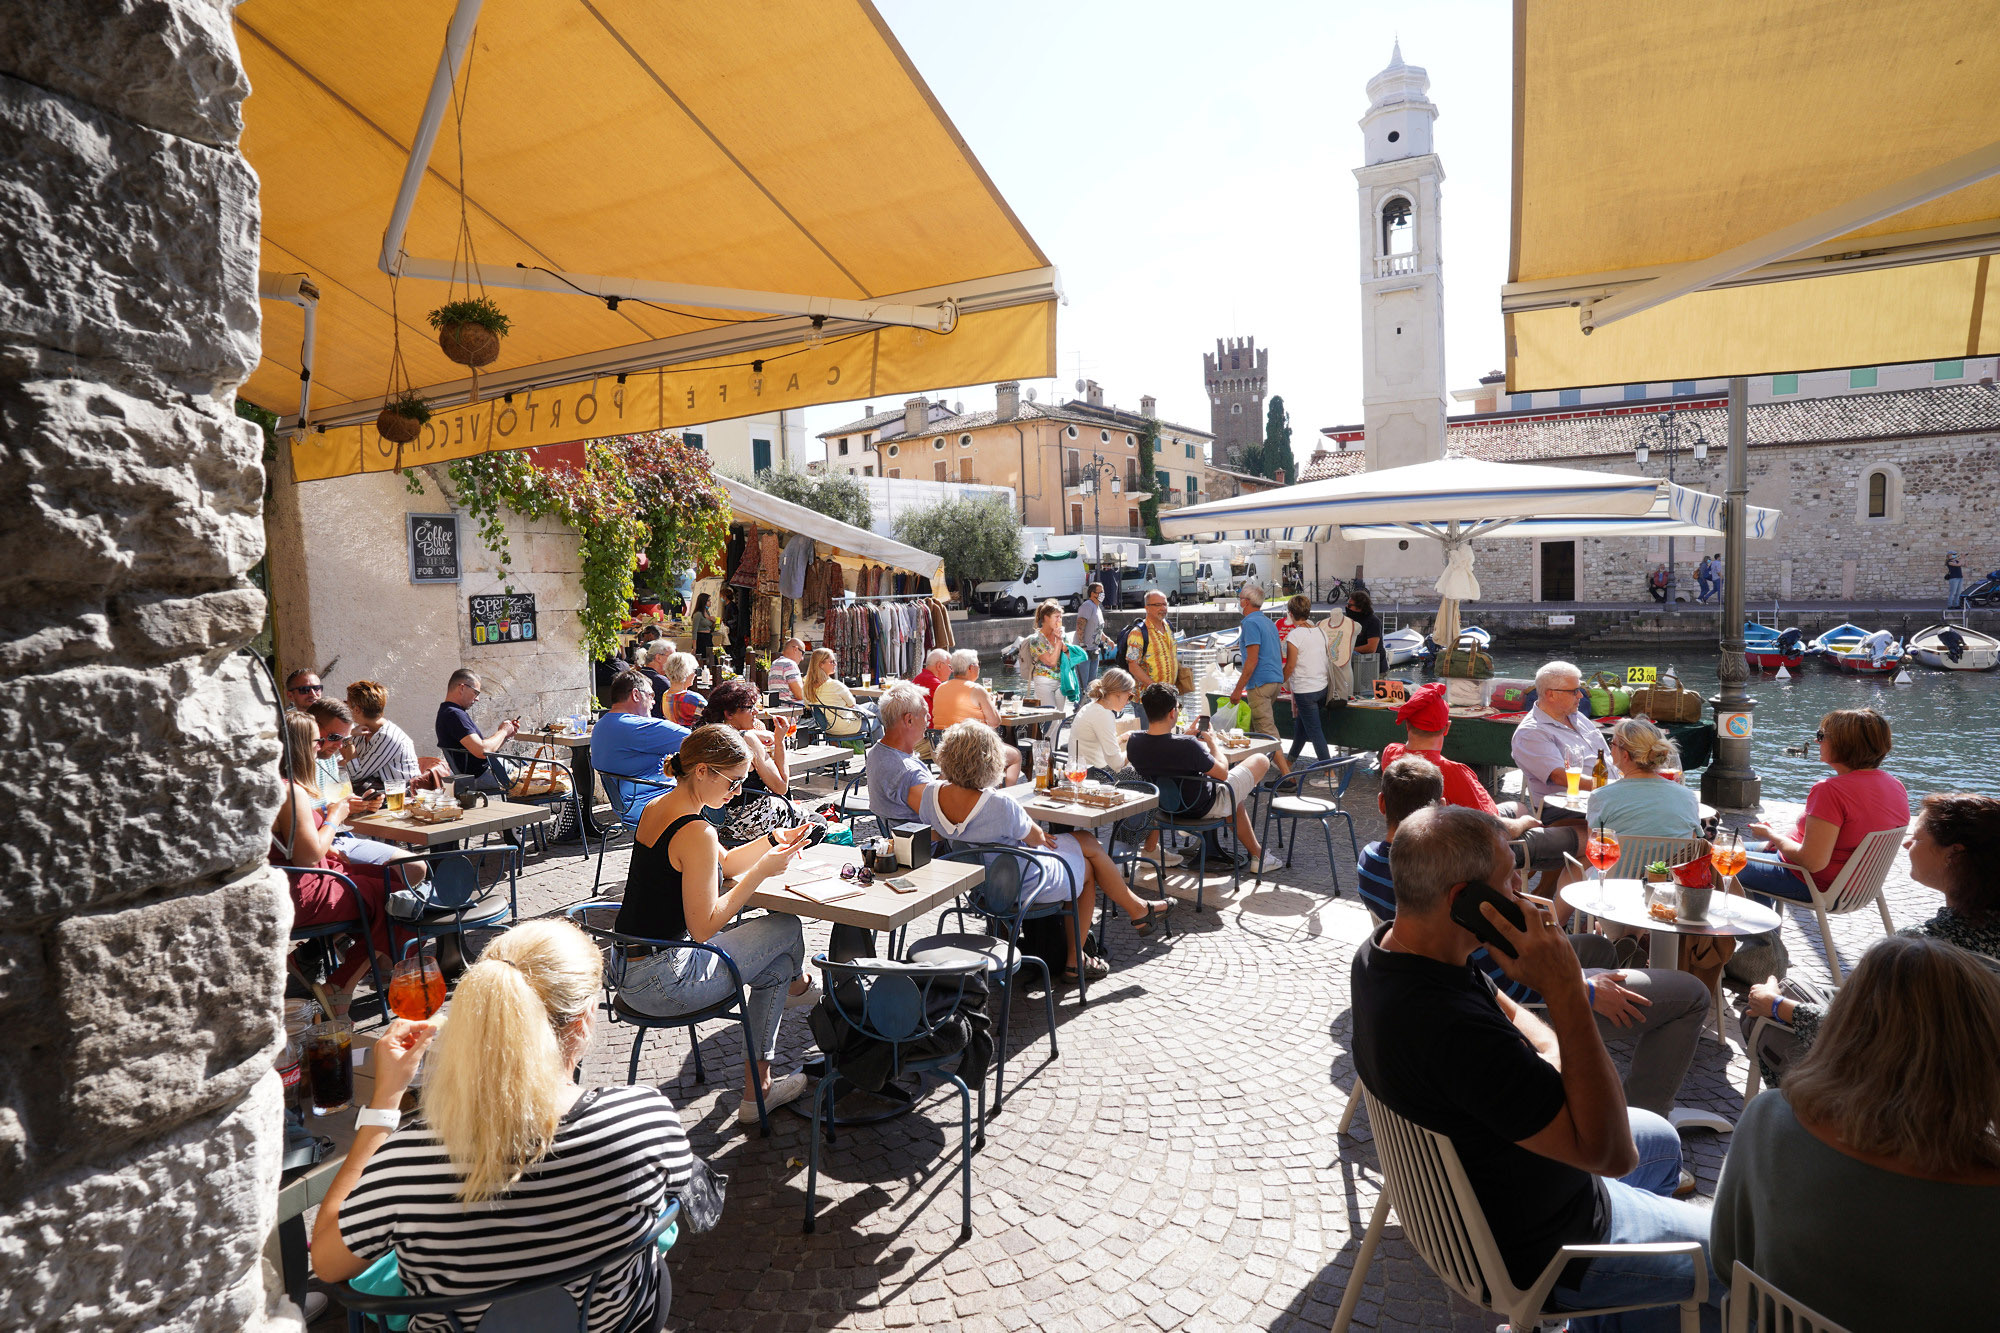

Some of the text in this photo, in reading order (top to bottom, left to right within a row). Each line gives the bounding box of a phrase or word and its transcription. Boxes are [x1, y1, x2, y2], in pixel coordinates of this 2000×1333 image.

[415, 525, 453, 548] Coffee
[417, 541, 451, 556] Break
[417, 566, 455, 575] FOR YOU
[475, 597, 522, 615] SPRIZ
